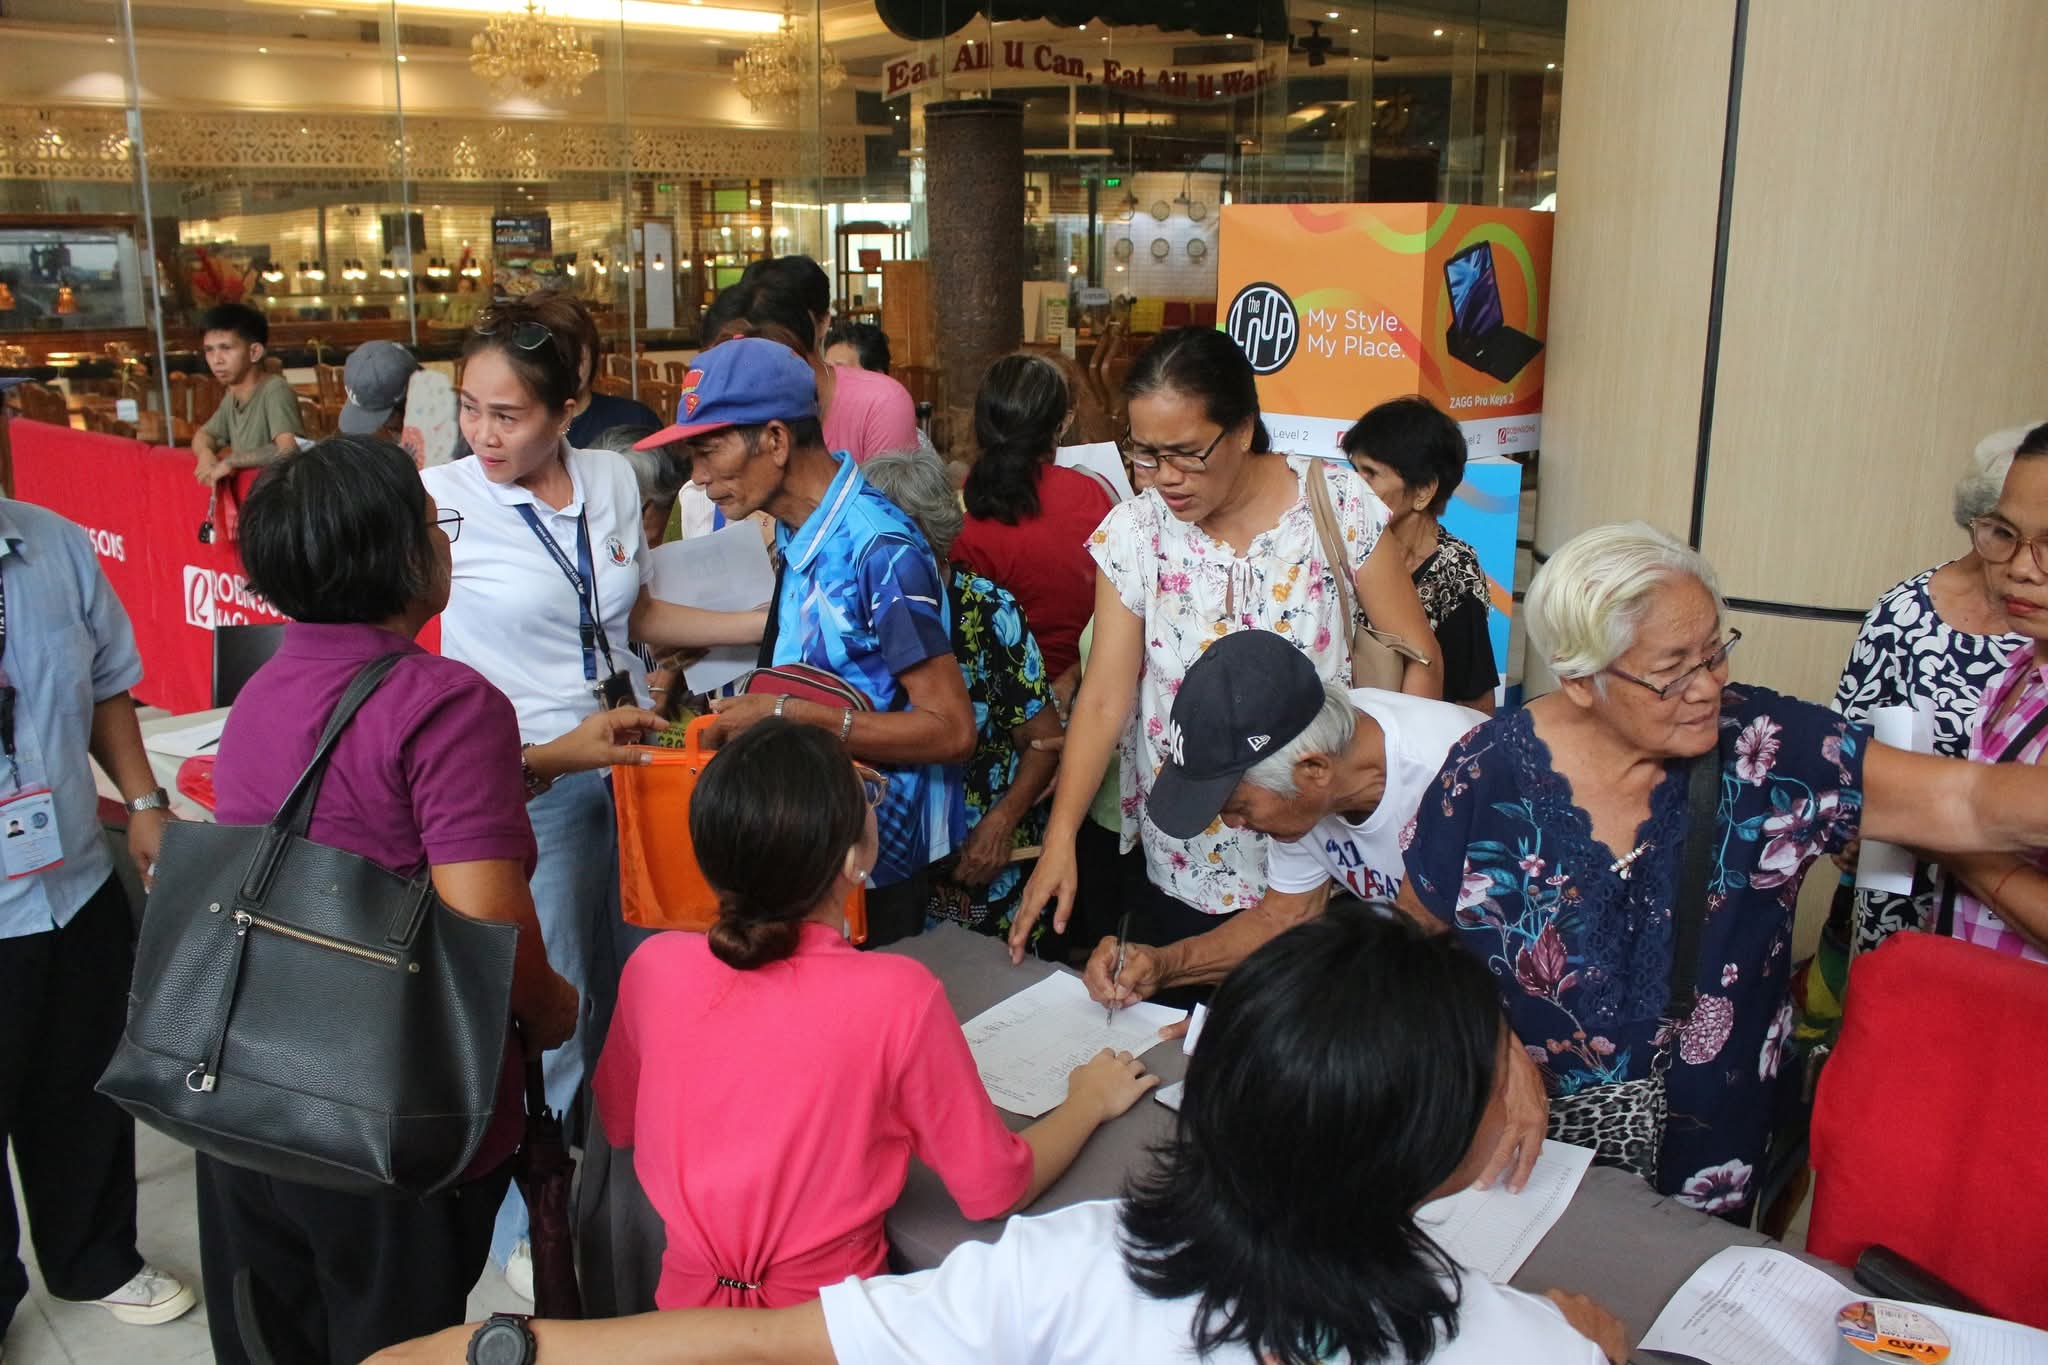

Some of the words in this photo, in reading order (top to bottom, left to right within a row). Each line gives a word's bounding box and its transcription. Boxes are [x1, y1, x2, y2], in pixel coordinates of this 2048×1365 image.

[887, 53, 940, 95] Eat
[952, 42, 994, 73] All
[1034, 44, 1093, 84] Can,
[1104, 59, 1146, 89] Eat
[1158, 69, 1187, 97] All
[1222, 61, 1278, 95] Want
[1248, 296, 1260, 313] the
[1233, 291, 1293, 365] LOOP
[1308, 309, 1337, 332] My
[1345, 309, 1403, 335] Style.
[1308, 334, 1337, 358] My
[1345, 335, 1406, 359] Place.
[1449, 395, 1473, 409] ZAGG
[1474, 395, 1488, 407] Pro
[1489, 394, 1508, 407] Keys
[1508, 393, 1515, 404] 2
[1273, 428, 1300, 440] Level
[1302, 431, 1309, 441] 2
